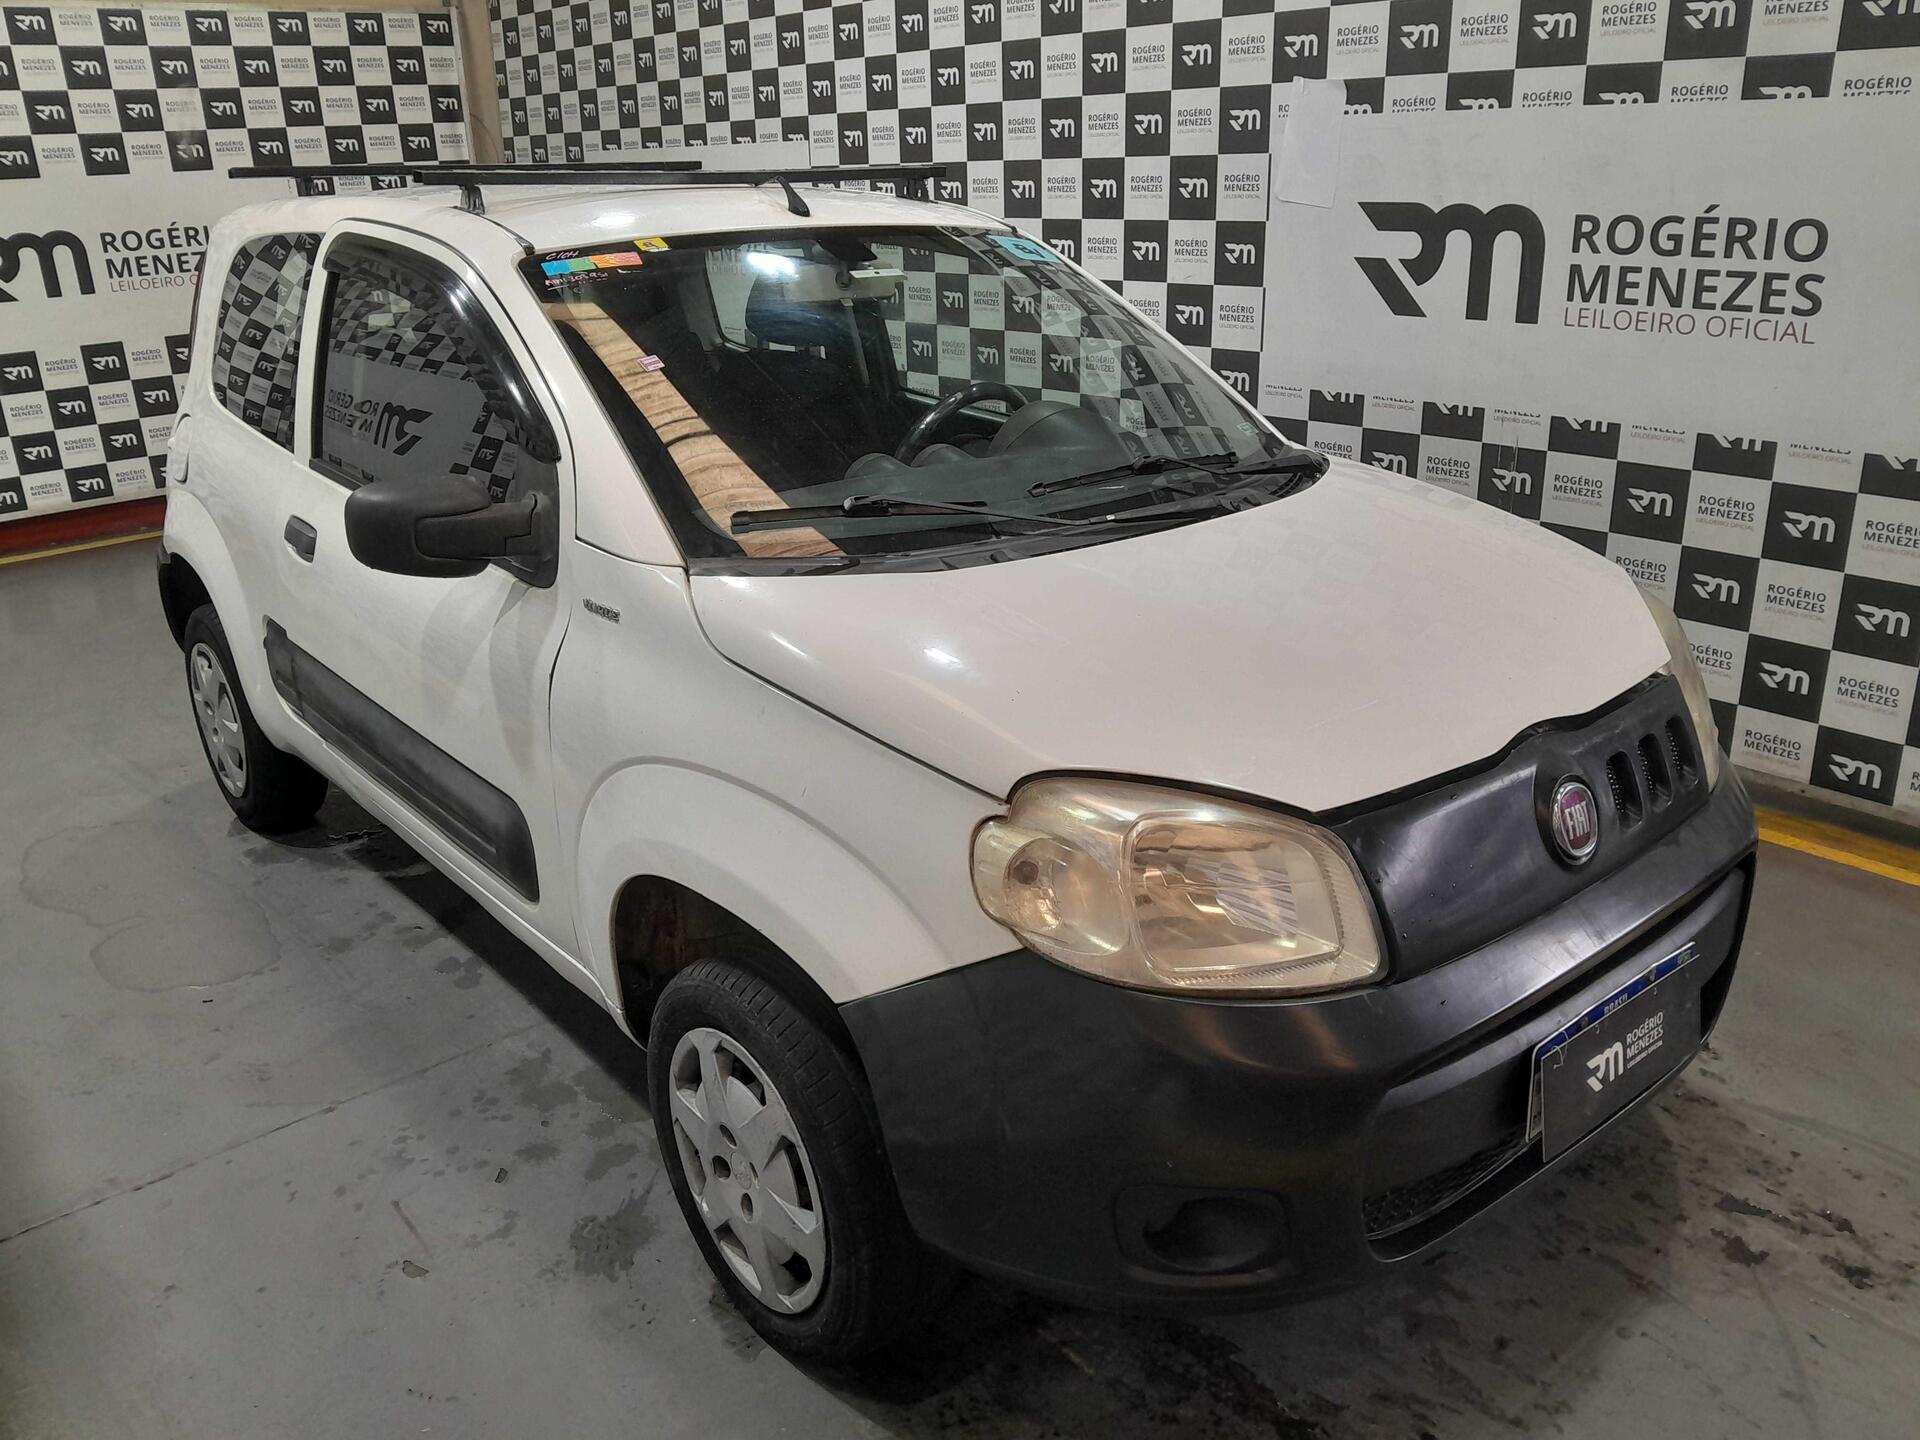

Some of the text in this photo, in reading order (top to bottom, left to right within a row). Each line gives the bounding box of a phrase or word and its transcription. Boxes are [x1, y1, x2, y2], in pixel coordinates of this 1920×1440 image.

[934, 6, 958, 16] ROGÉRIO
[1007, 4, 1035, 13] MENEZES
[1602, 1, 1656, 15] ROGÉRIO
[1764, 2, 1829, 16] MENEZES
[868, 16, 890, 24] ROGÉRIO
[934, 14, 959, 23] MENEZES
[1461, 14, 1508, 25] ROGÉRIO
[1601, 14, 1656, 27] MENEZES
[868, 24, 891, 32] MENEZES
[1337, 25, 1379, 36] ROGÉRIO
[1460, 25, 1508, 37] MENEZES
[1228, 35, 1265, 46] ROGÉRIO
[1337, 35, 1379, 47] MENEZES
[1132, 45, 1165, 55] ROGÉRIO
[1228, 46, 1265, 56] MENEZES
[1047, 53, 1076, 62] ROGÉRIO
[1132, 54, 1165, 64] MENEZES
[970, 61, 996, 69] ROGÉRIO
[1047, 62, 1076, 71] MENEZES
[902, 68, 925, 76] ROGÉRIO
[970, 69, 997, 78] MENEZES
[840, 74, 861, 83] ROGÉRIO
[902, 76, 926, 84] MENEZES
[1843, 75, 1912, 90] ROGÉRIO
[840, 82, 862, 90] MENEZES
[1671, 83, 1728, 96] ROGÉRIO
[1522, 90, 1573, 101] ROGÉRIO
[1392, 96, 1436, 108] ROGÉRIO
[1089, 113, 1119, 122] ROGÉRIO
[1178, 108, 1212, 118] ROGÉRIO
[937, 122, 961, 131] ROGÉRIO
[1008, 118, 1035, 127] ROGÉRIO
[1089, 122, 1119, 131] MENEZES
[1177, 117, 1212, 127] MENEZES
[872, 126, 894, 134] ROGÉRIO
[937, 130, 961, 138] MENEZES
[1008, 126, 1036, 135] MENEZES
[872, 133, 895, 141] MENEZES
[972, 178, 998, 186] ROGÉRIO
[1047, 177, 1076, 185] ROGÉRIO
[1131, 175, 1162, 184] ROGÉRIO
[1224, 173, 1260, 183] ROGÉRIO
[973, 185, 999, 194] MENEZES
[1047, 185, 1076, 193] MENEZES
[1131, 184, 1163, 193] MENEZES
[1224, 182, 1260, 192] MENEZES
[100, 222, 209, 253] ROGÉRI
[1570, 203, 1829, 262] ROGÉRIO
[1087, 236, 1117, 246] ROGÉRIO
[1175, 239, 1208, 248] ROGÉRIO
[1088, 245, 1117, 254] MENEZES
[1174, 248, 1208, 257] MENEZES
[105, 251, 207, 279] MENEZ
[110, 276, 184, 292] LEILOEIRO
[1566, 264, 1826, 317] MENEZES
[1220, 304, 1254, 314] ROGÉRIO
[1219, 313, 1254, 323] MENEZES
[1563, 308, 1815, 345] LEILOEIRO OFICIAL
[1314, 441, 1352, 453] ROGÉRIO
[1427, 456, 1470, 469] ROGÉRIO
[1426, 466, 1470, 479] MENEZES
[1554, 474, 1602, 488] ROGÉRIO
[1553, 484, 1602, 498] MENEZES
[1699, 495, 1755, 511] ROGÉRIO
[1698, 506, 1754, 522] MENEZES
[1866, 520, 1920, 536] ROGÉRI
[1864, 531, 1920, 548] MENEZE
[1616, 556, 1666, 573] ROGÉRIO
[1625, 568, 1666, 582] ENEZES
[1768, 584, 1826, 602] ROGÉRIO
[1766, 594, 1825, 613] MENEZES
[1689, 643, 1733, 660] OGÉRIO
[1697, 656, 1732, 670] NEZES
[1839, 676, 1900, 697] ROGÉRIO
[1837, 687, 1898, 708] MENEZES
[1745, 730, 1801, 750] ROGÉRIO
[1744, 740, 1800, 761] MENEZES
[1565, 801, 1590, 840] FIAT
[1627, 1012, 1663, 1045] ROGÉRIO
[1627, 1025, 1663, 1059] MENEZES
